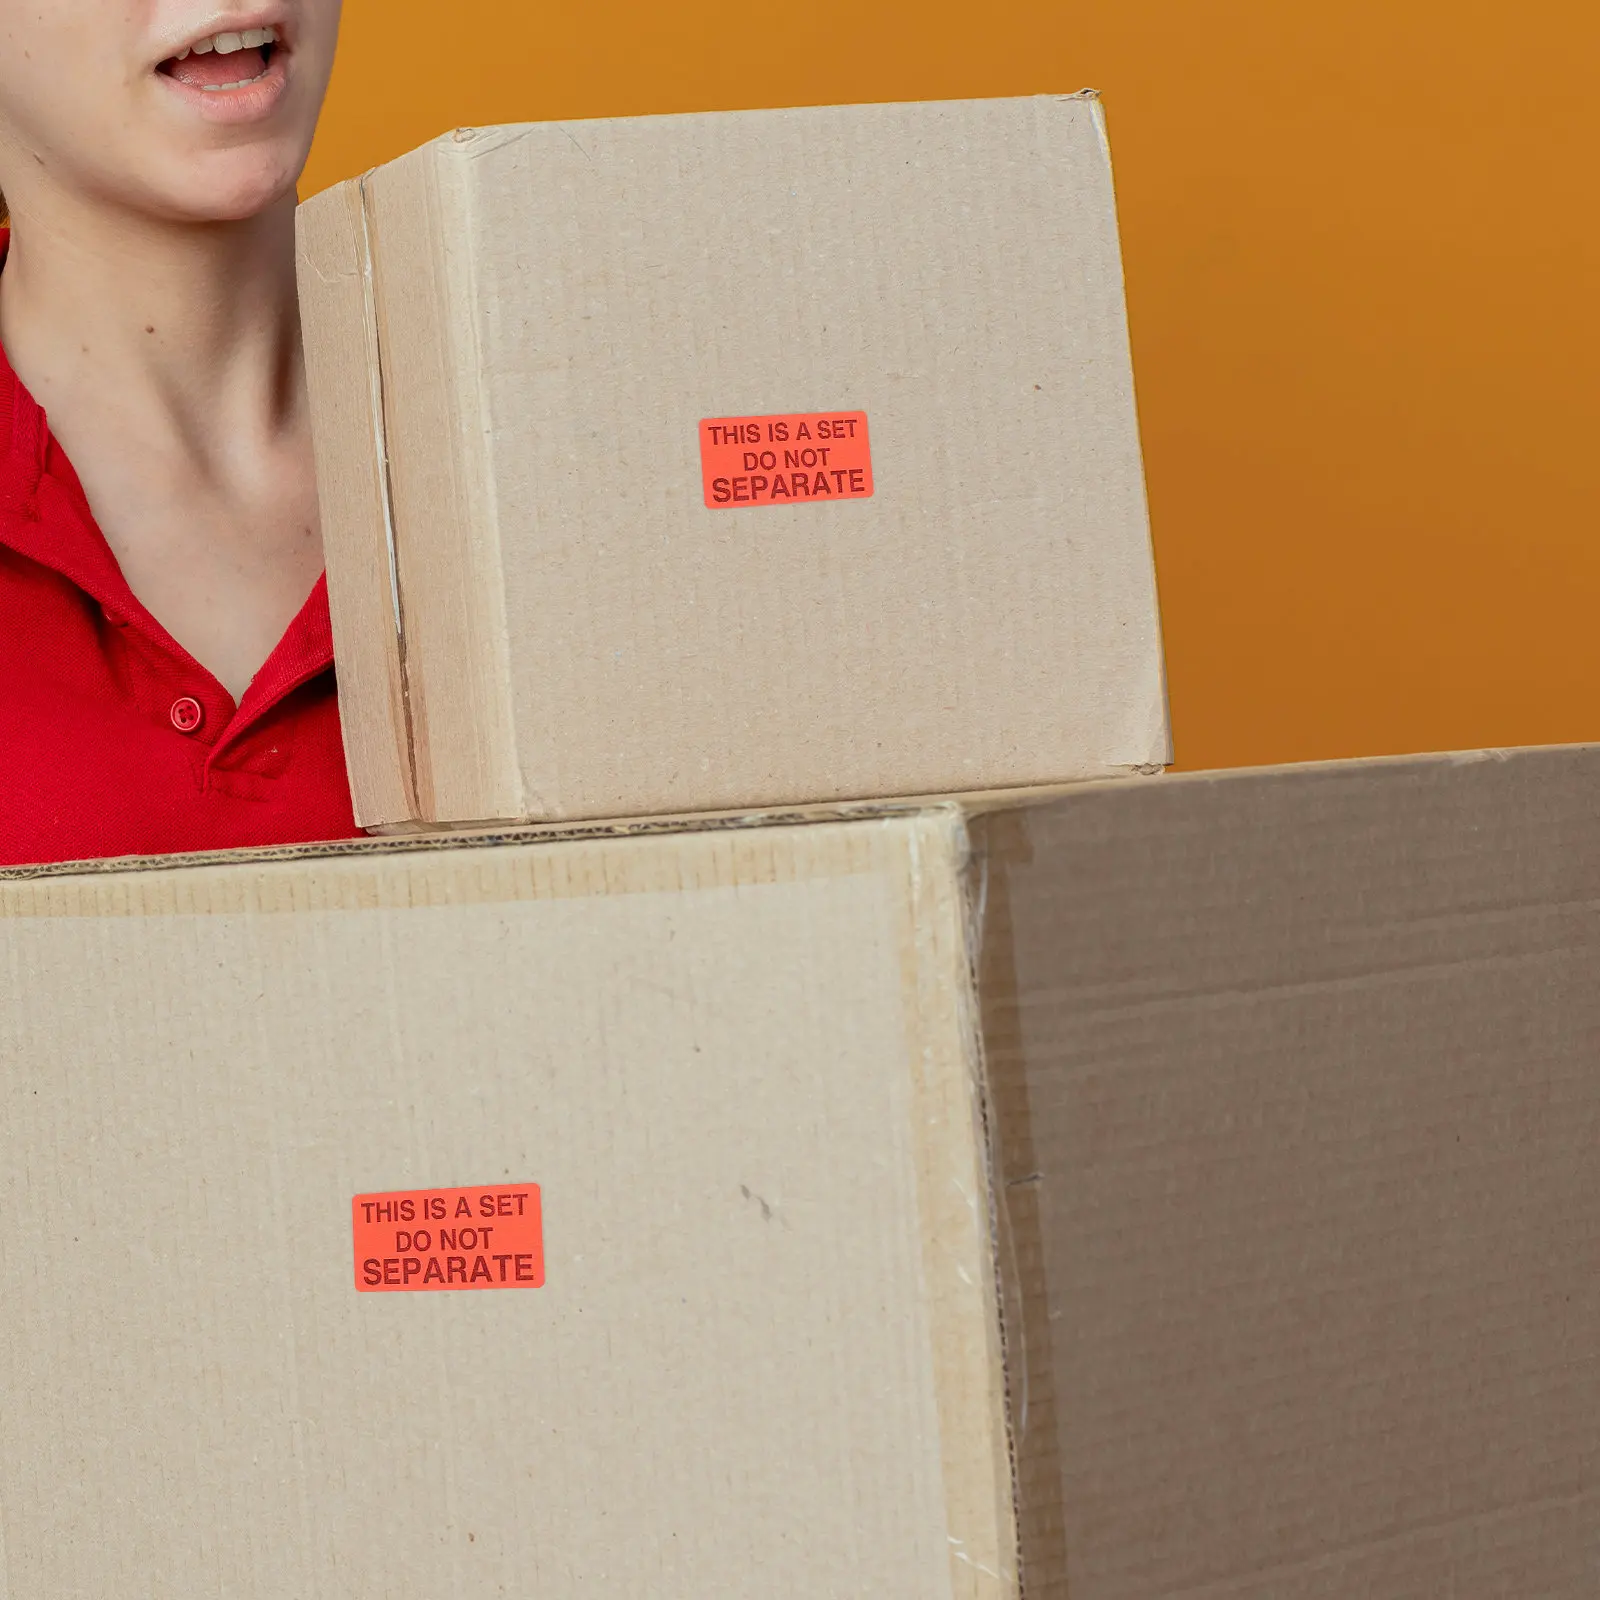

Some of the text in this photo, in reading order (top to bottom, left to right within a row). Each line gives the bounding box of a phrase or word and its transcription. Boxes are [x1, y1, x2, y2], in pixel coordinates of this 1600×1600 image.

[707, 419, 857, 445] THIS IS A SET
[743, 448, 831, 471] DO NOT
[712, 468, 865, 503] SEPARATE
[361, 1193, 529, 1223] THIS IS A SET
[396, 1227, 494, 1253] DO NOT
[363, 1254, 534, 1286] SEPARATE
